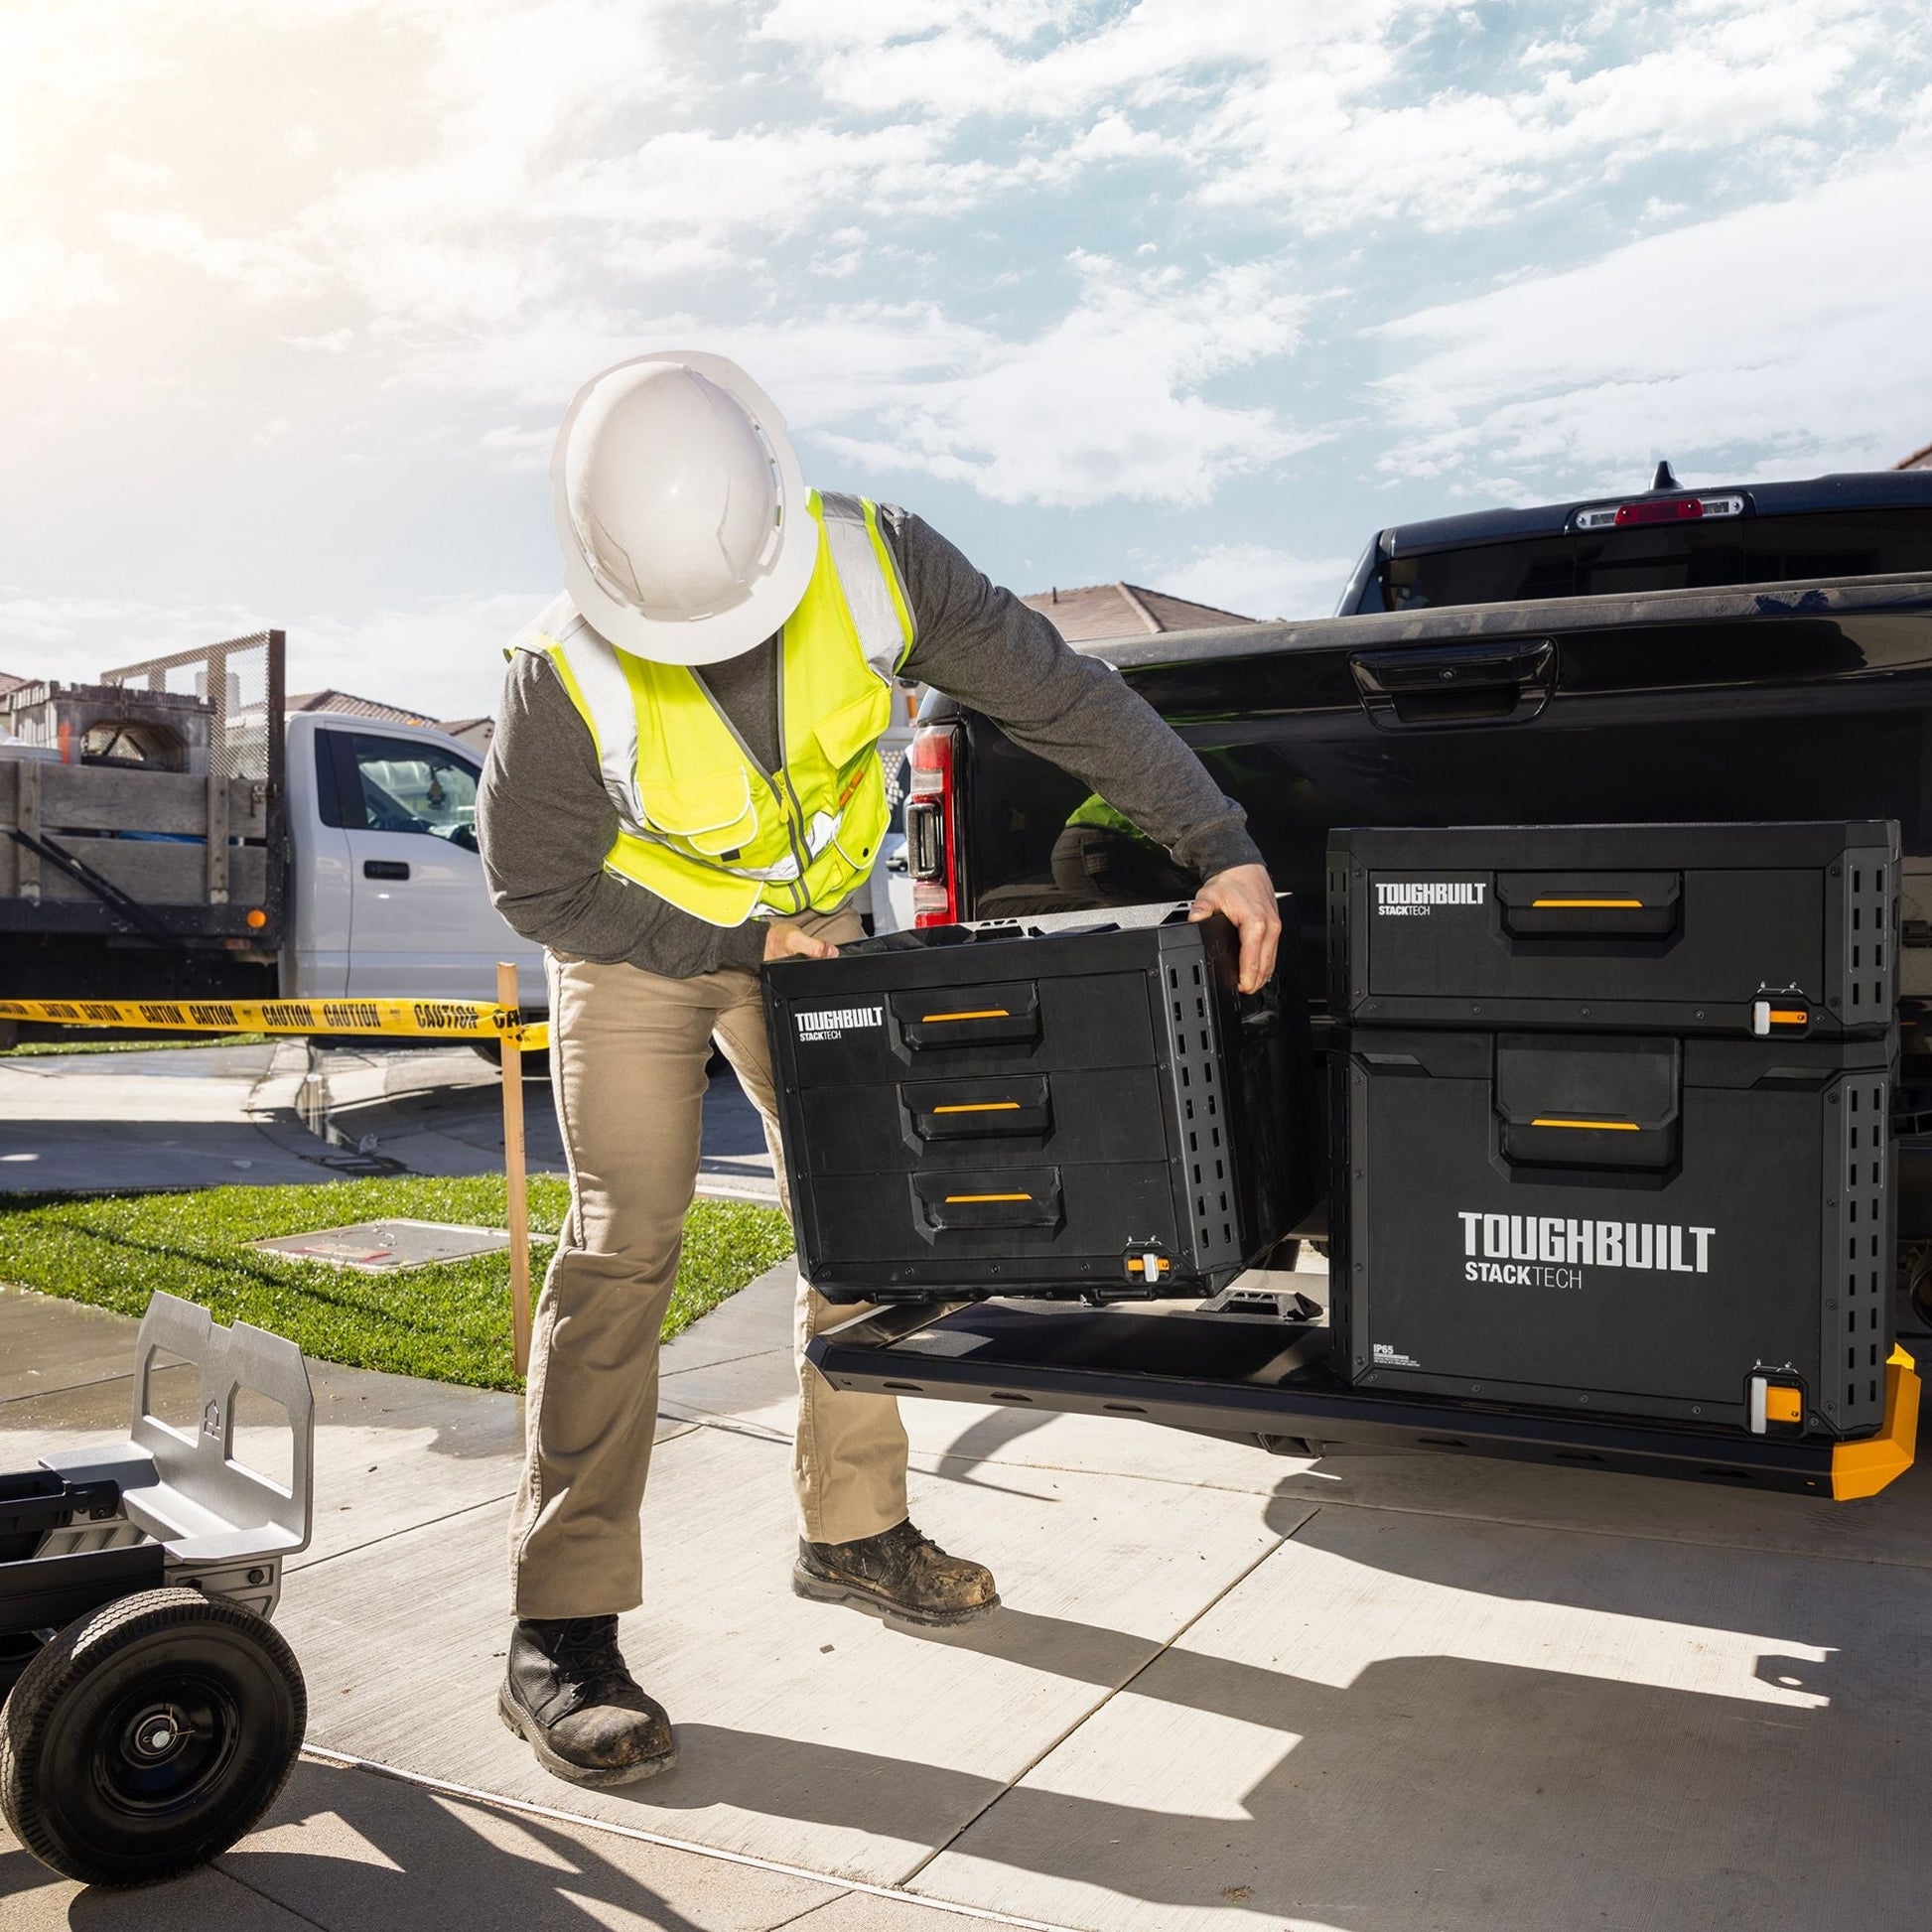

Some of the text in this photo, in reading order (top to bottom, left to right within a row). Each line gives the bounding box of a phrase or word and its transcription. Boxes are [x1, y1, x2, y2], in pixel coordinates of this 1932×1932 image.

[1375, 883, 1486, 904] TOUGHBUILT
[1378, 905, 1431, 915] STACKTECH
[139, 1005, 187, 1024] CAUTION
[189, 1005, 238, 1026] CAUTION
[261, 1005, 316, 1027] CAUTION
[323, 1003, 381, 1028] CAUTION
[414, 1004, 480, 1030] CAUTION
[794, 1007, 883, 1032] TOUGHBUILT
[799, 1030, 842, 1041] STACKTECH
[1457, 1211, 1716, 1273] TOUGHBUILT
[1464, 1261, 1583, 1290] STACKTECH
[1373, 1343, 1394, 1354] IP65
